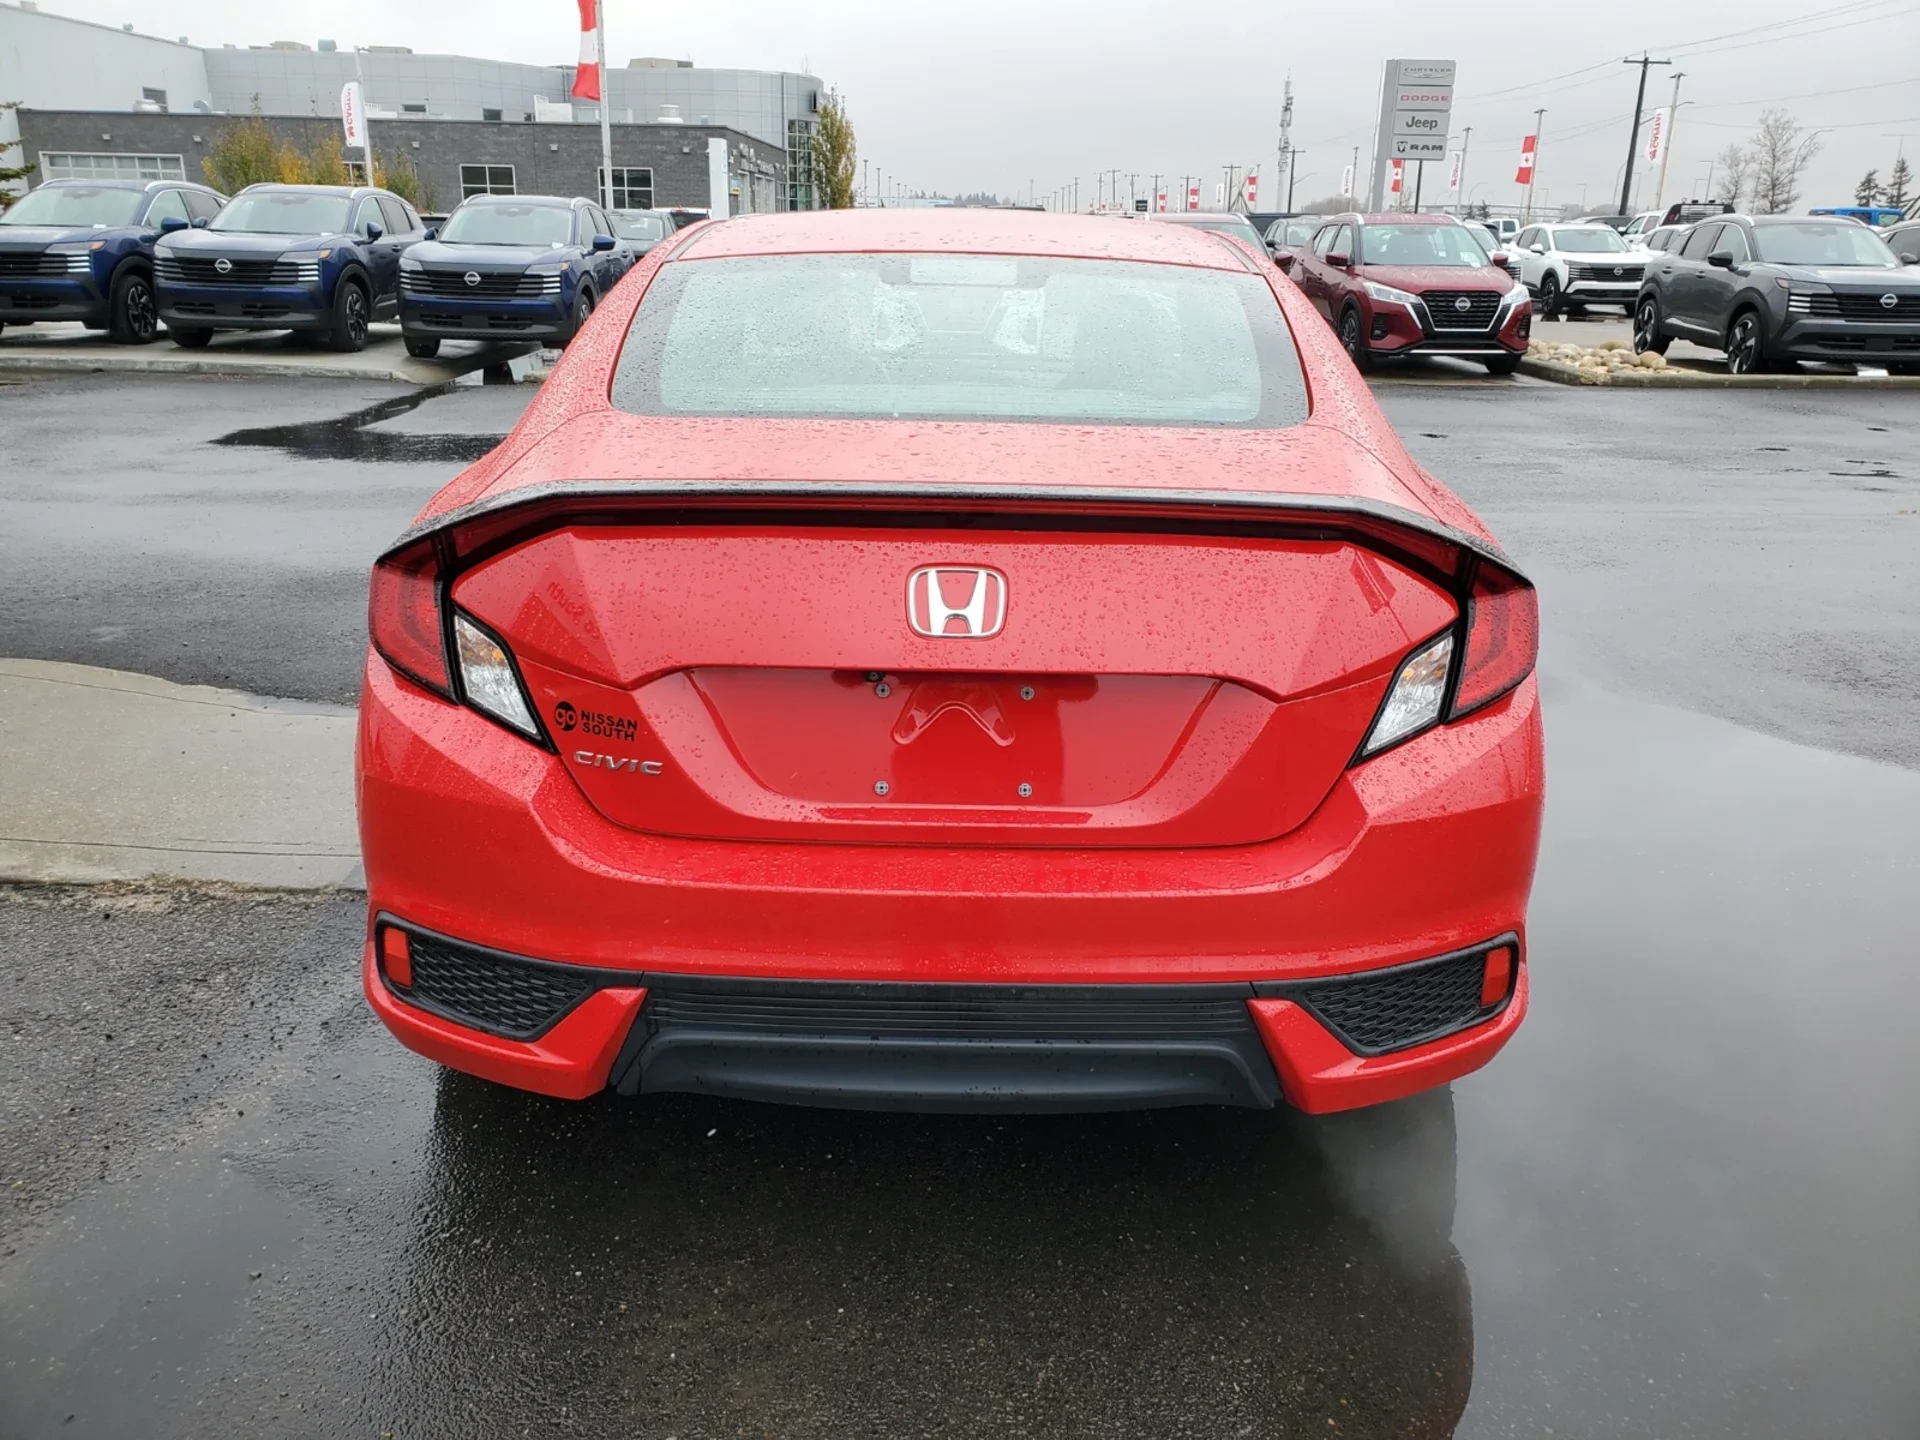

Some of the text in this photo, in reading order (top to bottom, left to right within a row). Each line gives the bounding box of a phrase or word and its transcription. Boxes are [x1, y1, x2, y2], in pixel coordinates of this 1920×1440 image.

[1405, 116, 1438, 131] Jeep
[581, 710, 637, 730] NISSAN
[582, 722, 635, 741] SOUTH
[574, 750, 664, 775] CIVIC
